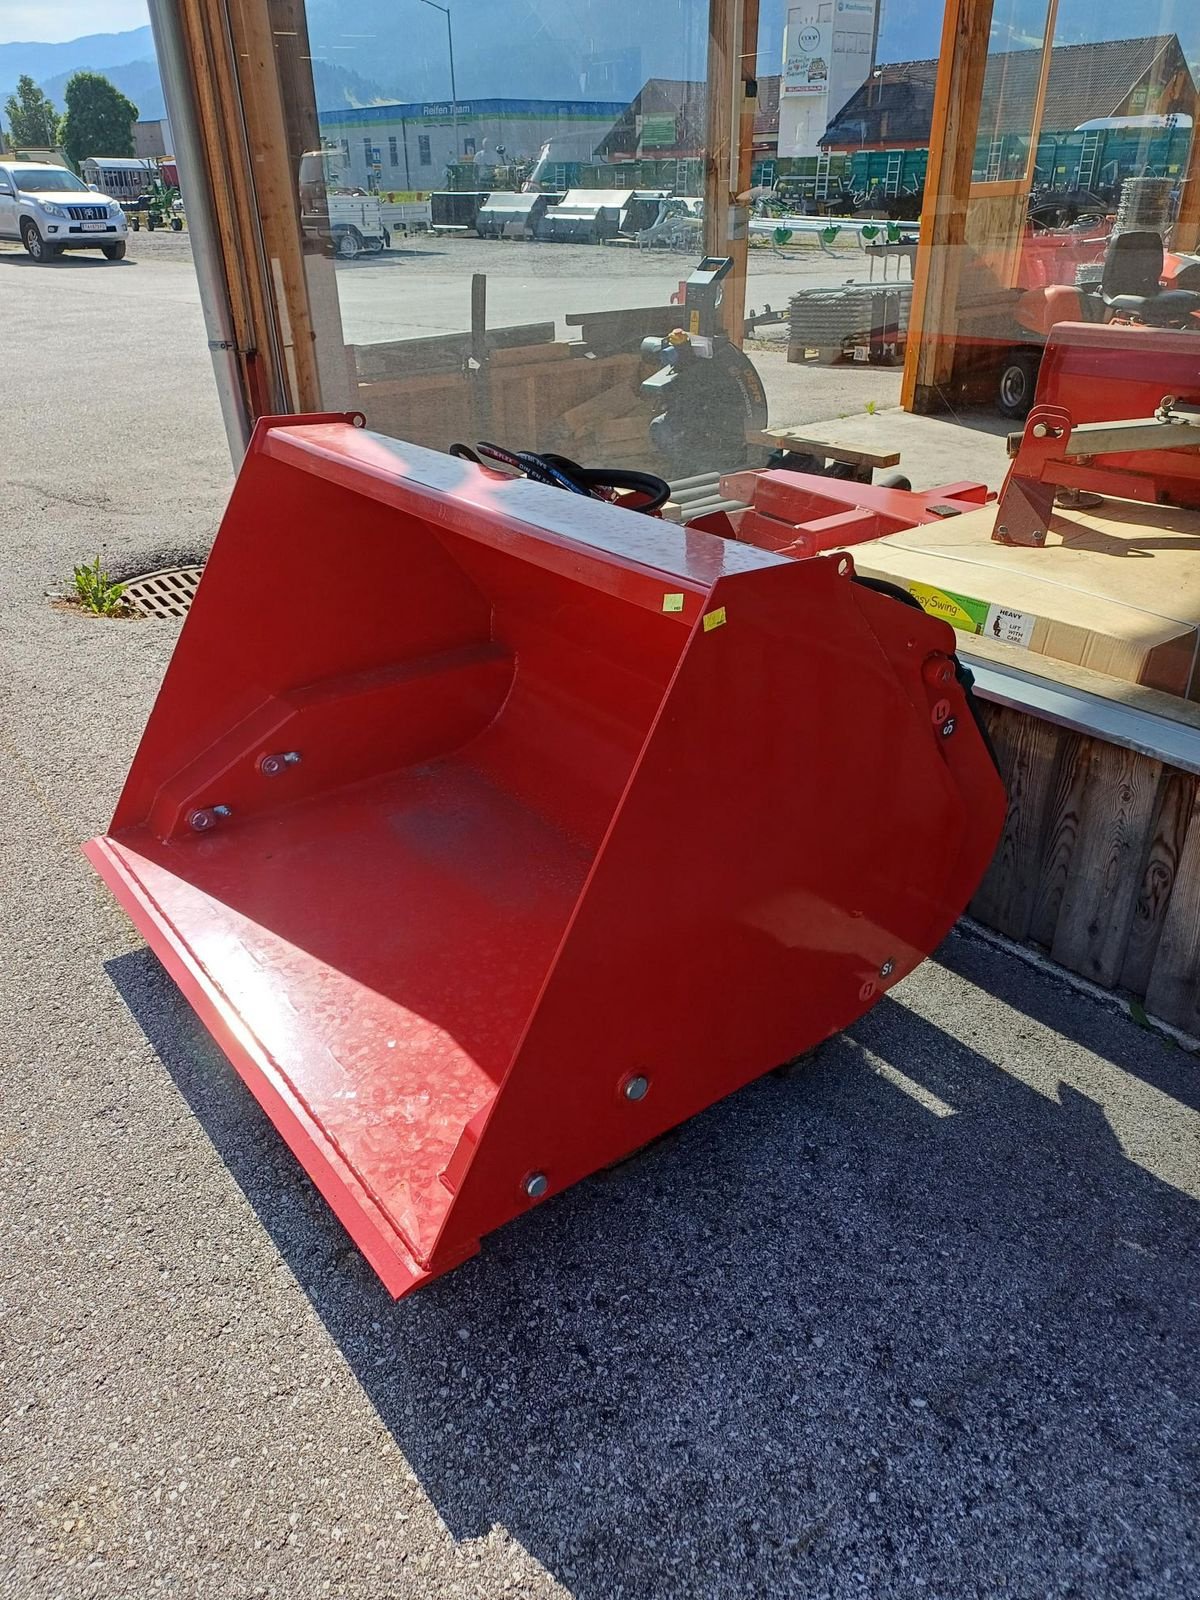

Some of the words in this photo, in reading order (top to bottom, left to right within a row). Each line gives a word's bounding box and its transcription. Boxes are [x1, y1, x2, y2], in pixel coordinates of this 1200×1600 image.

[423, 104, 448, 116] Reifen
[930, 595, 957, 616] Swing
[1000, 609, 1023, 620] HEAVY
[1006, 634, 1022, 643] CARE
[1008, 629, 1024, 638] WITH
[943, 719, 955, 735] S1
[881, 963, 893, 976] S1
